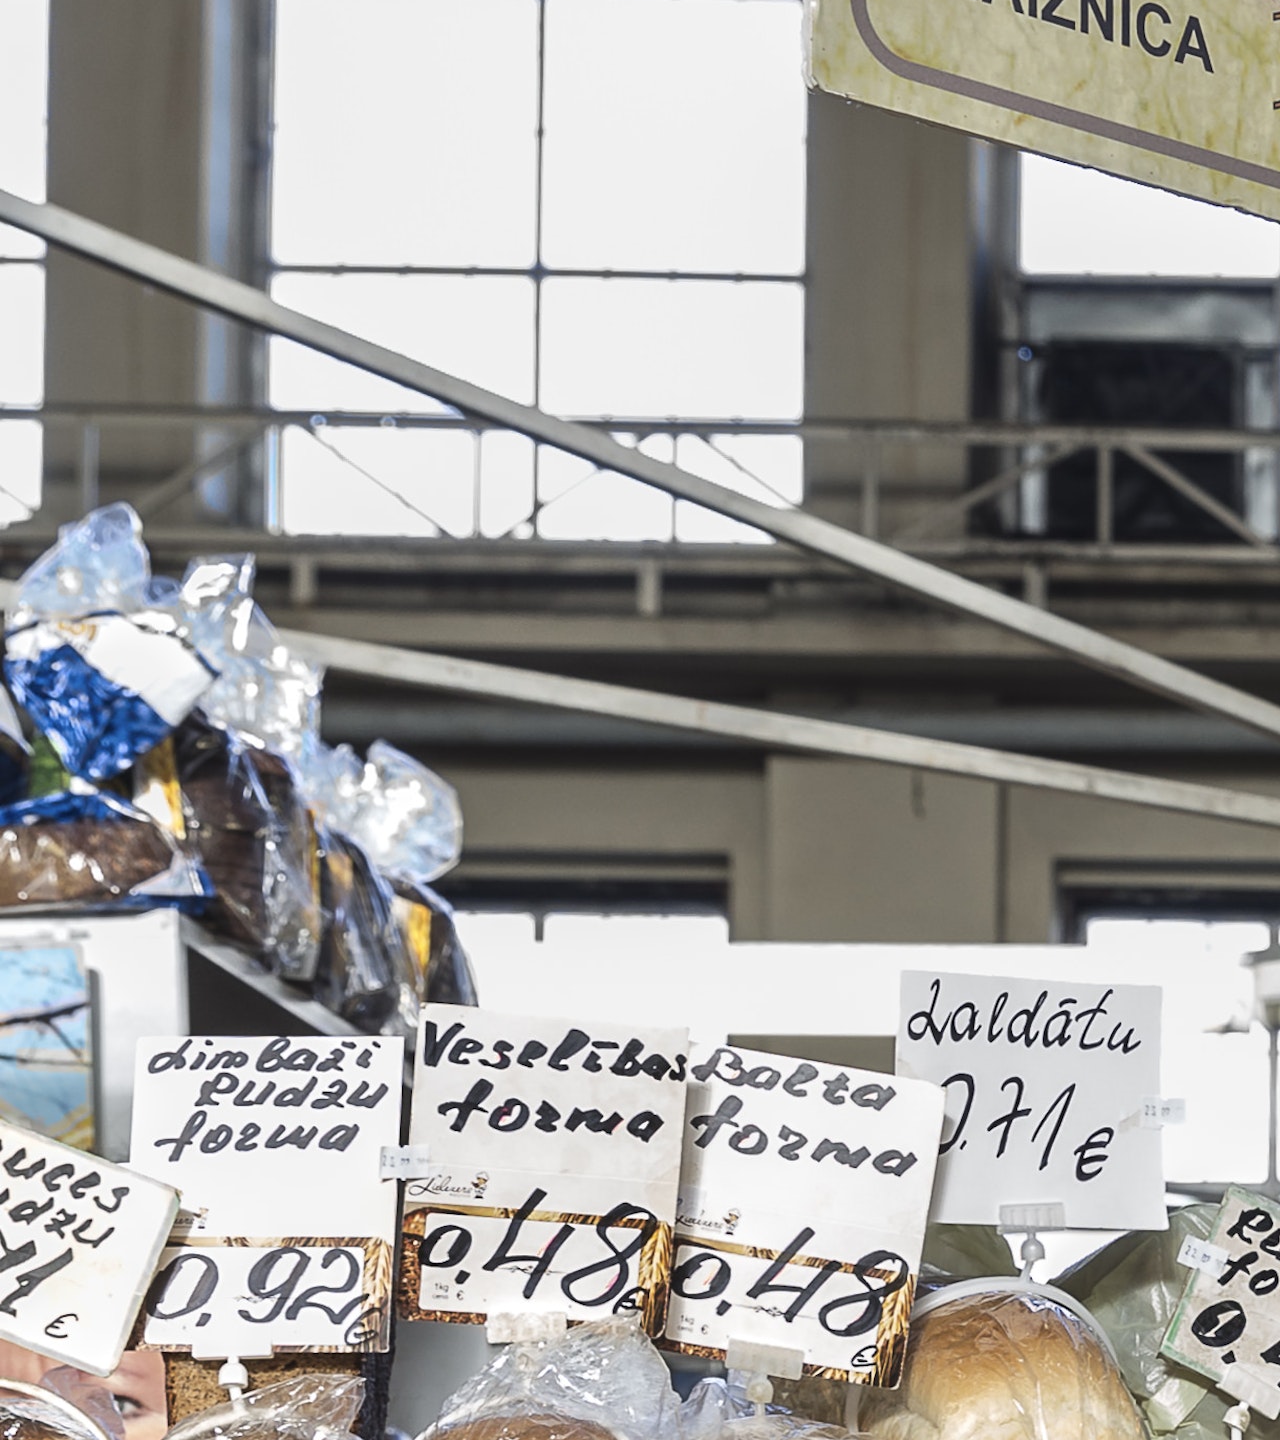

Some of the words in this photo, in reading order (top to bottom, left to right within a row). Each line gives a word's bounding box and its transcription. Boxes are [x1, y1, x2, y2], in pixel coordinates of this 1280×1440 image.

[424, 1018, 688, 1085] Veselības
[1073, 1126, 1115, 1183] €
[44, 1312, 80, 1339] €
